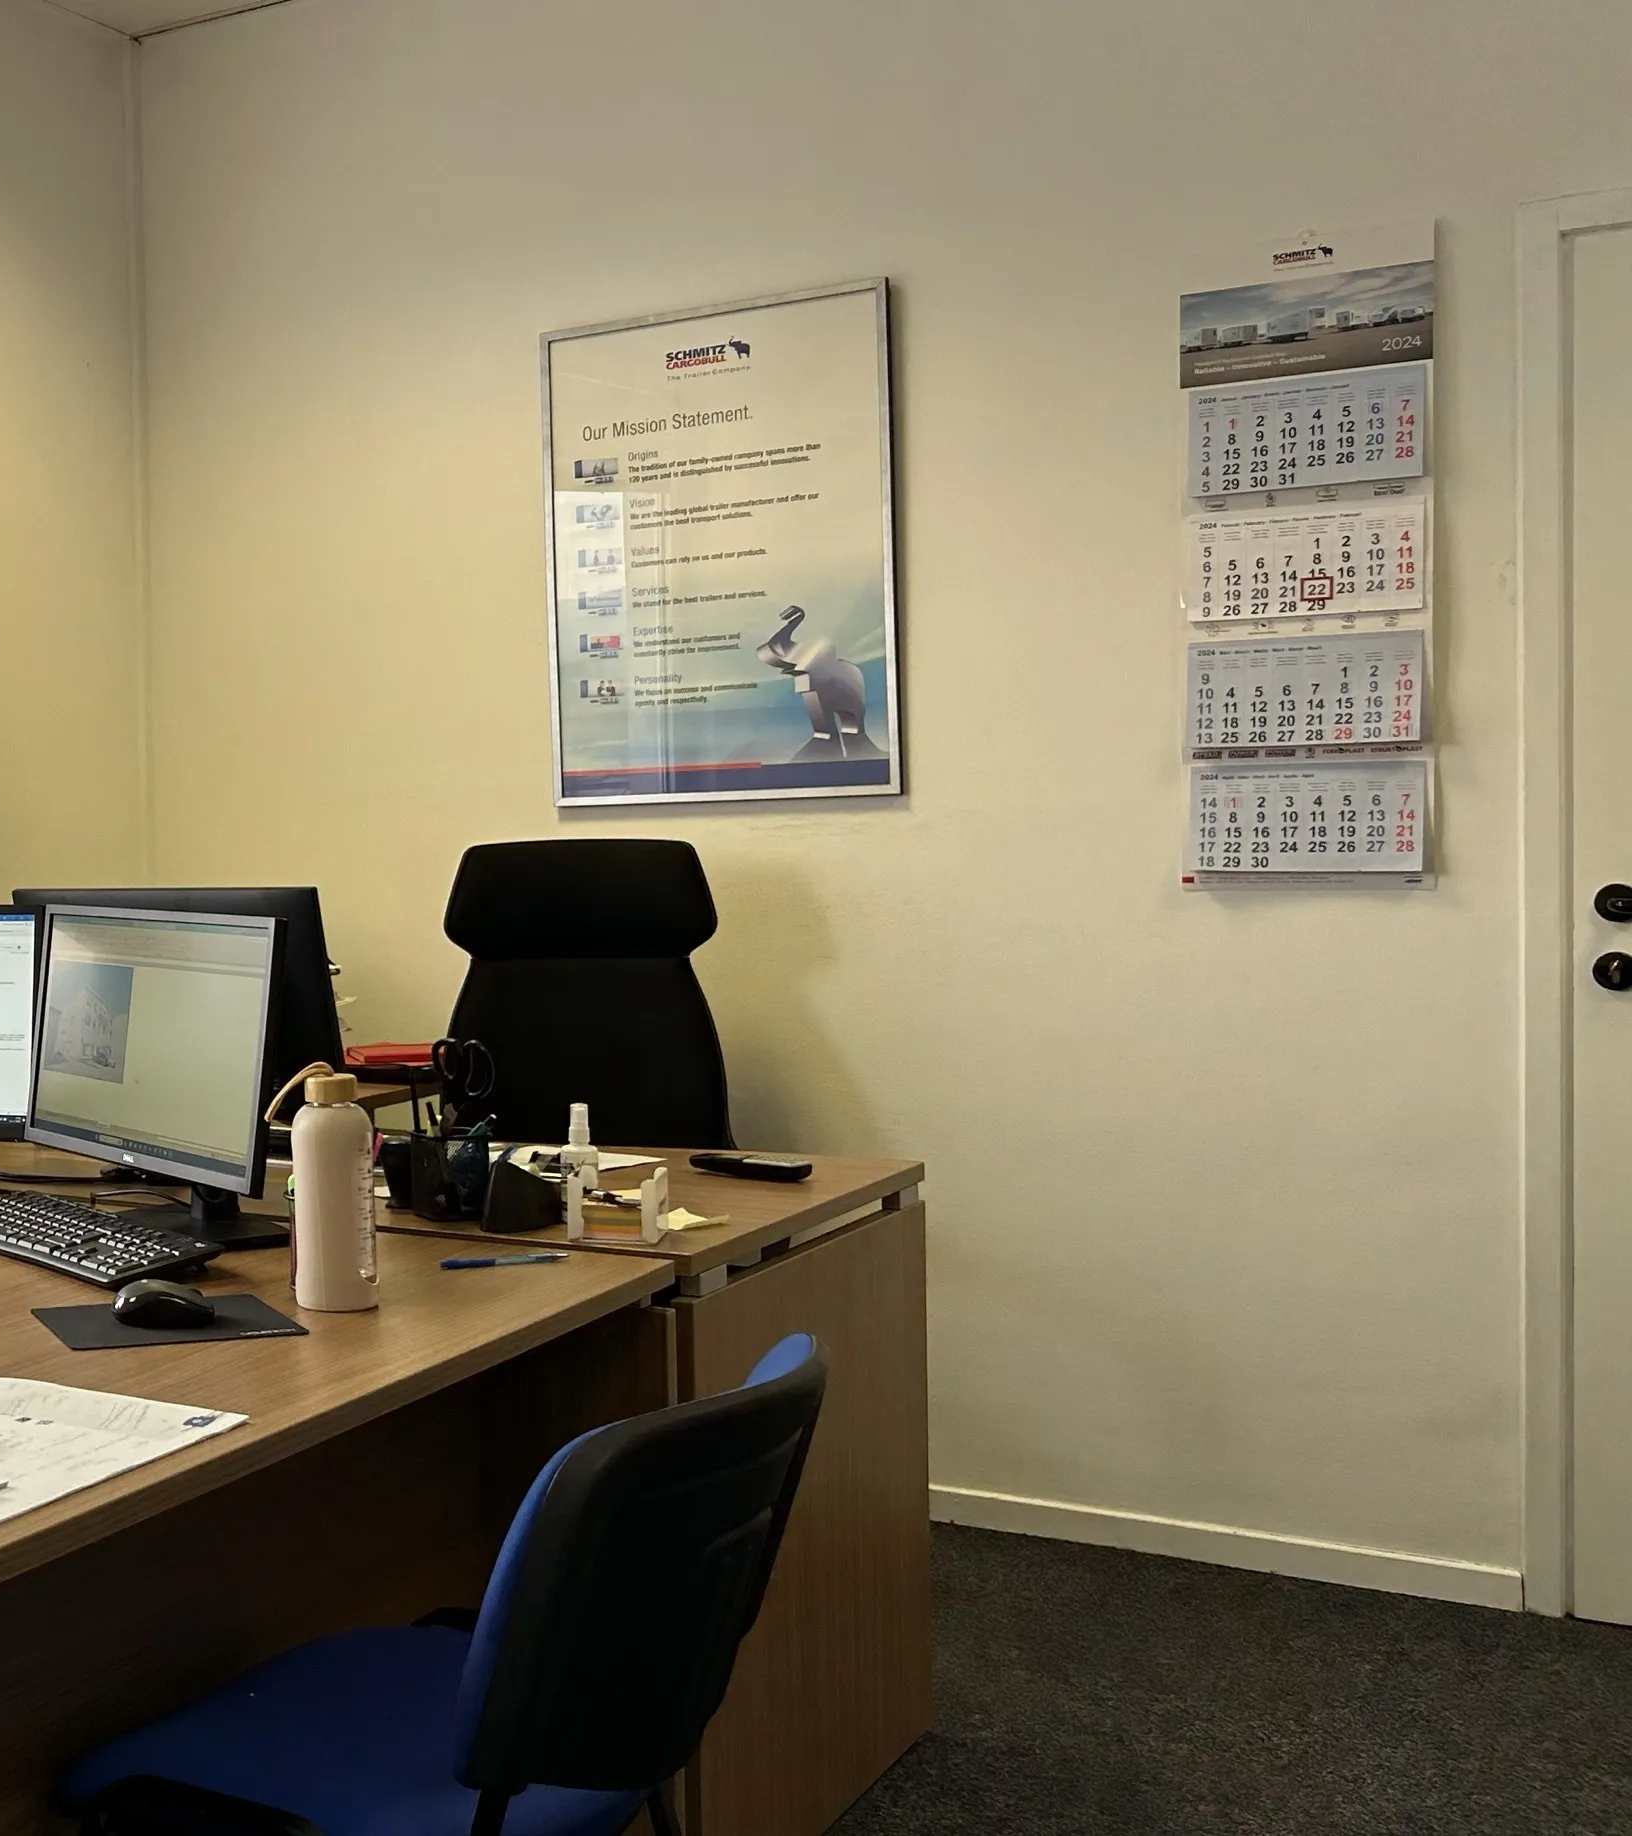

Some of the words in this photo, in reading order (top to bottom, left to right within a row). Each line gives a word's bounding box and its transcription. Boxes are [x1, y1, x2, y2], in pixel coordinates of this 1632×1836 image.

[1273, 249, 1316, 260] SCHMITZ
[1381, 335, 1422, 352] 2024
[666, 344, 726, 362] SCHMITZ
[666, 355, 726, 370] CARGOBULL
[1194, 366, 1224, 374] Reliable
[684, 371, 711, 379] Trailer
[1198, 397, 1217, 405] 2024
[582, 426, 607, 442] Our
[612, 418, 667, 438] Mission
[672, 405, 753, 429] Statement.
[1203, 421, 1209, 433] 1
[1229, 418, 1235, 430] 1
[1256, 415, 1265, 427] 2
[1284, 412, 1293, 424] 3
[1312, 409, 1322, 420] 4
[1342, 405, 1351, 417] 5
[1371, 402, 1380, 414] 6
[1401, 399, 1410, 411] 7
[1202, 436, 1211, 448] 2
[1228, 433, 1236, 445] 8
[1255, 430, 1264, 442] 9
[1280, 427, 1297, 439] 10
[1309, 424, 1324, 436] 11
[1337, 420, 1355, 433] 12
[1366, 417, 1385, 430] 13
[1397, 414, 1415, 427] 14
[1202, 451, 1211, 463] 3
[1224, 448, 1241, 460] 15
[1251, 445, 1268, 457] 16
[1279, 442, 1297, 454] 17
[1308, 439, 1325, 451] 18
[1337, 436, 1354, 449] 19
[1365, 433, 1384, 446] 20
[1396, 430, 1413, 443] 21
[628, 450, 658, 462] Origins
[641, 463, 667, 471] tradition
[734, 451, 763, 460] company
[1201, 466, 1210, 477] 4
[1222, 463, 1240, 476] 22
[1250, 460, 1268, 473] 23
[1278, 457, 1297, 470] 24
[1307, 454, 1325, 467] 25
[1336, 451, 1355, 464] 26
[1365, 448, 1384, 461] 27
[1395, 445, 1414, 459] 28
[641, 474, 658, 483] years
[680, 465, 723, 476] distinguished
[734, 460, 768, 470] successful
[1202, 481, 1210, 493] 5
[1222, 478, 1240, 491] 29
[1250, 475, 1268, 488] 30
[1278, 473, 1295, 485] 31
[629, 499, 655, 508] Vision
[664, 508, 687, 516] leading
[689, 505, 708, 514] global
[710, 503, 729, 511] trailer
[731, 498, 774, 508] manufacturer
[776, 495, 788, 503] and
[630, 522, 662, 530] customers
[691, 514, 720, 523] transport
[631, 546, 659, 556] Values
[1203, 546, 1212, 558] 5
[1314, 538, 1320, 549] 1
[1342, 535, 1351, 547] 2
[1371, 533, 1380, 545] 3
[1400, 530, 1410, 542] 4
[631, 559, 664, 568] Customers
[711, 552, 723, 560] and
[632, 586, 669, 597] Services
[1203, 591, 1212, 603] 8
[1224, 589, 1241, 601] 19
[1251, 587, 1269, 600] 20
[1279, 585, 1296, 598] 21
[1308, 583, 1326, 596] 22
[1336, 581, 1355, 594] 23
[1366, 579, 1385, 592] 24
[1396, 577, 1415, 590] 25
[643, 599, 661, 608] stand
[700, 594, 722, 602] trailers
[633, 625, 673, 636] Expertise
[1197, 649, 1215, 657] 2024
[634, 674, 682, 685] Personality
[1197, 688, 1214, 700] 10
[1226, 687, 1235, 698] 4
[1254, 686, 1263, 698] 5
[1283, 684, 1291, 696] 6
[1311, 683, 1320, 695] 7
[1340, 682, 1349, 694] 8
[1369, 681, 1378, 693] 9
[1395, 679, 1413, 691] 10
[1200, 773, 1218, 781] 2024
[1201, 797, 1217, 809] 14
[1230, 797, 1236, 808] 1
[1257, 796, 1266, 808] 2
[1285, 796, 1294, 808] 3
[1313, 795, 1322, 807] 4
[1343, 795, 1352, 807] 5
[1371, 794, 1381, 806] 6
[1401, 793, 1411, 805] 7
[1199, 841, 1216, 853] 17
[1223, 841, 1241, 853] 22
[1251, 841, 1270, 853] 23
[1279, 841, 1298, 853] 24
[1308, 841, 1327, 853] 25
[1337, 841, 1356, 853] 26
[1366, 840, 1385, 852] 27
[1396, 840, 1415, 852] 28
